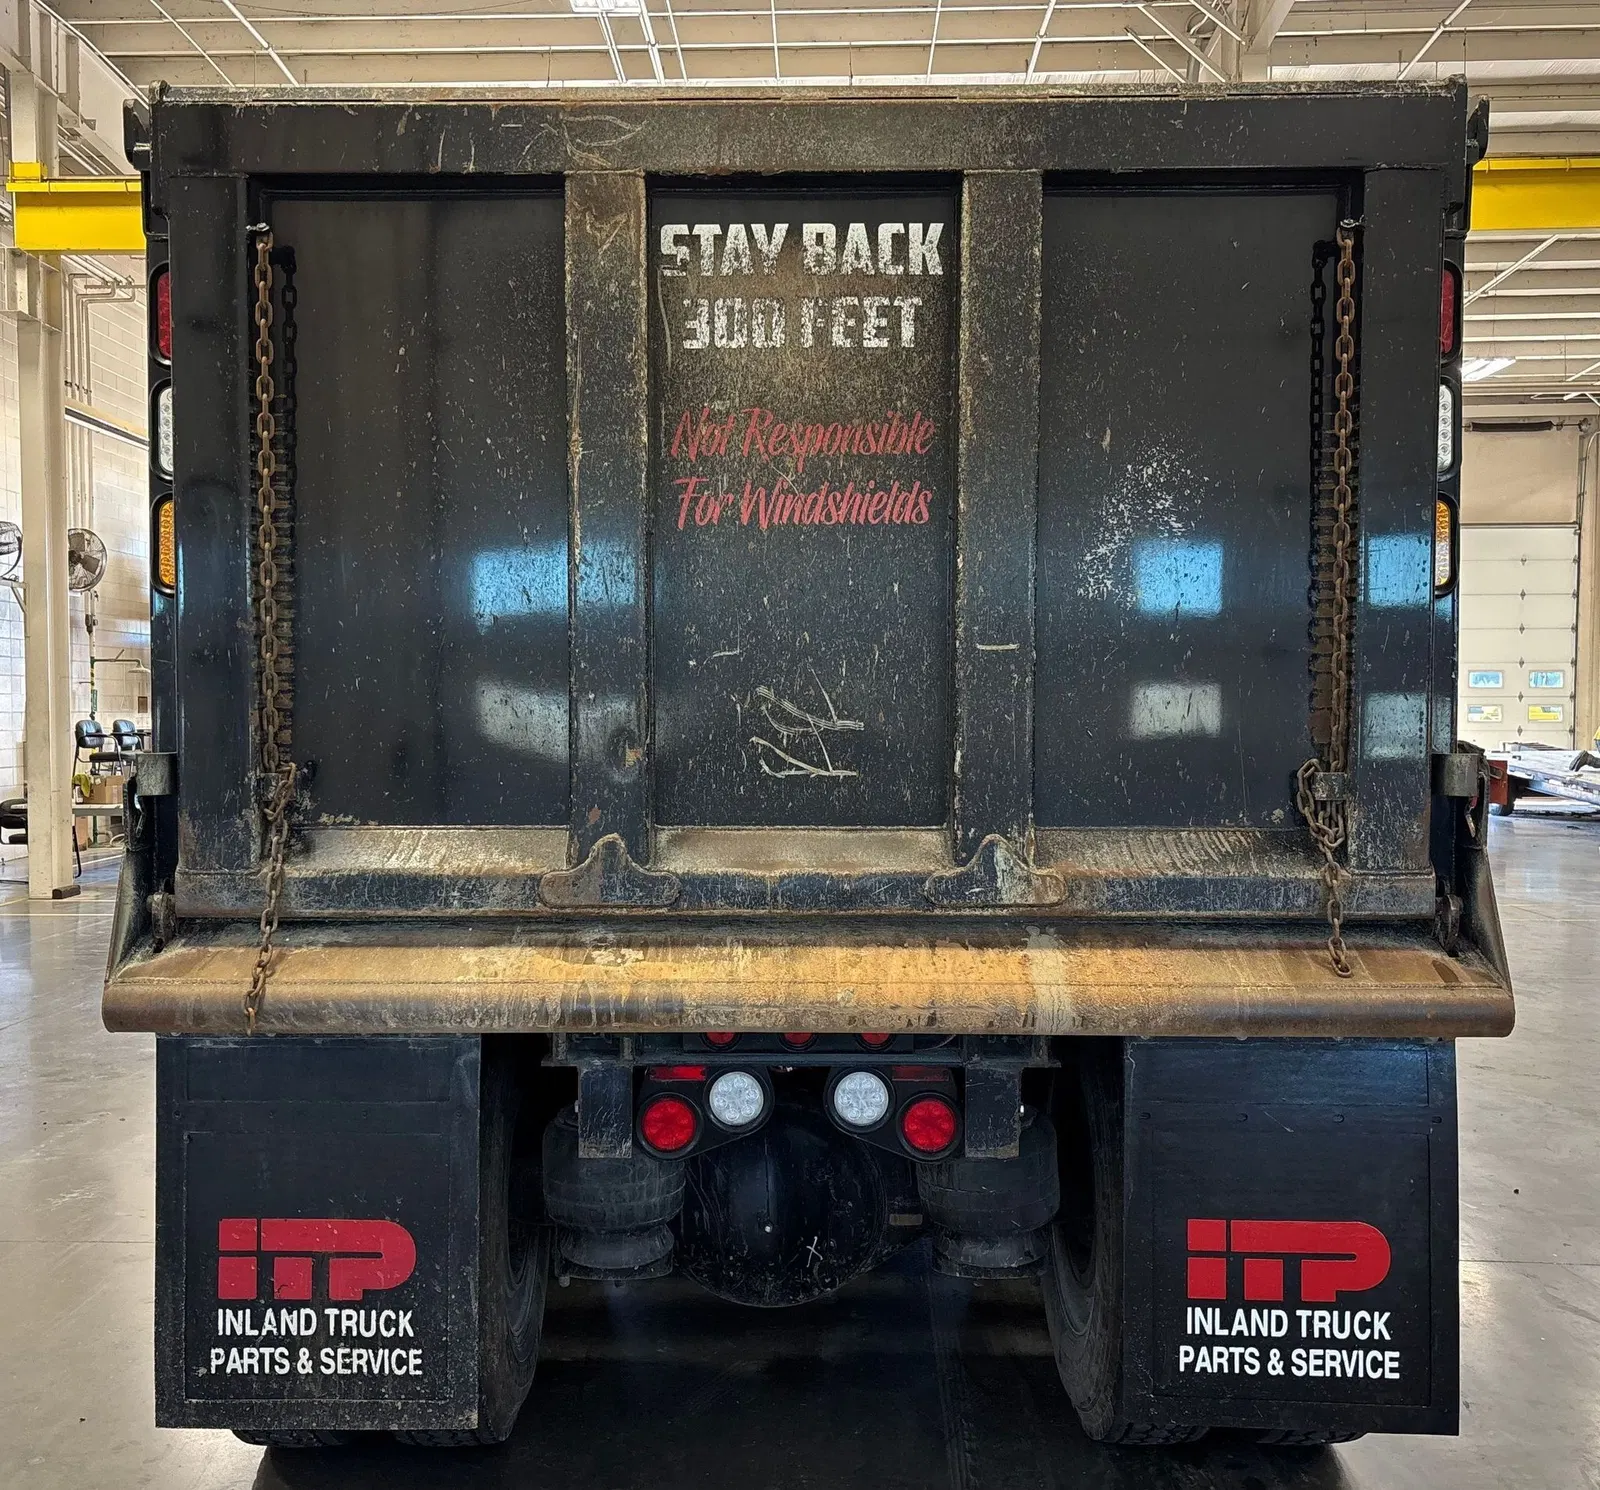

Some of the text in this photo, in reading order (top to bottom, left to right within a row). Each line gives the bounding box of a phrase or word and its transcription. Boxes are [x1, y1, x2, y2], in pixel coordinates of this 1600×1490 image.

[660, 223, 945, 276] STAY BACK
[682, 296, 786, 349] 300
[671, 407, 935, 472] Not Responsible
[674, 476, 933, 530] For Windshields
[218, 1308, 415, 1338] INLAND TRUCK
[1186, 1307, 1392, 1340] INLAND TRUCK
[210, 1347, 423, 1376] PARTS & SERVICE
[1179, 1345, 1400, 1379] PARTS & SERVICE
